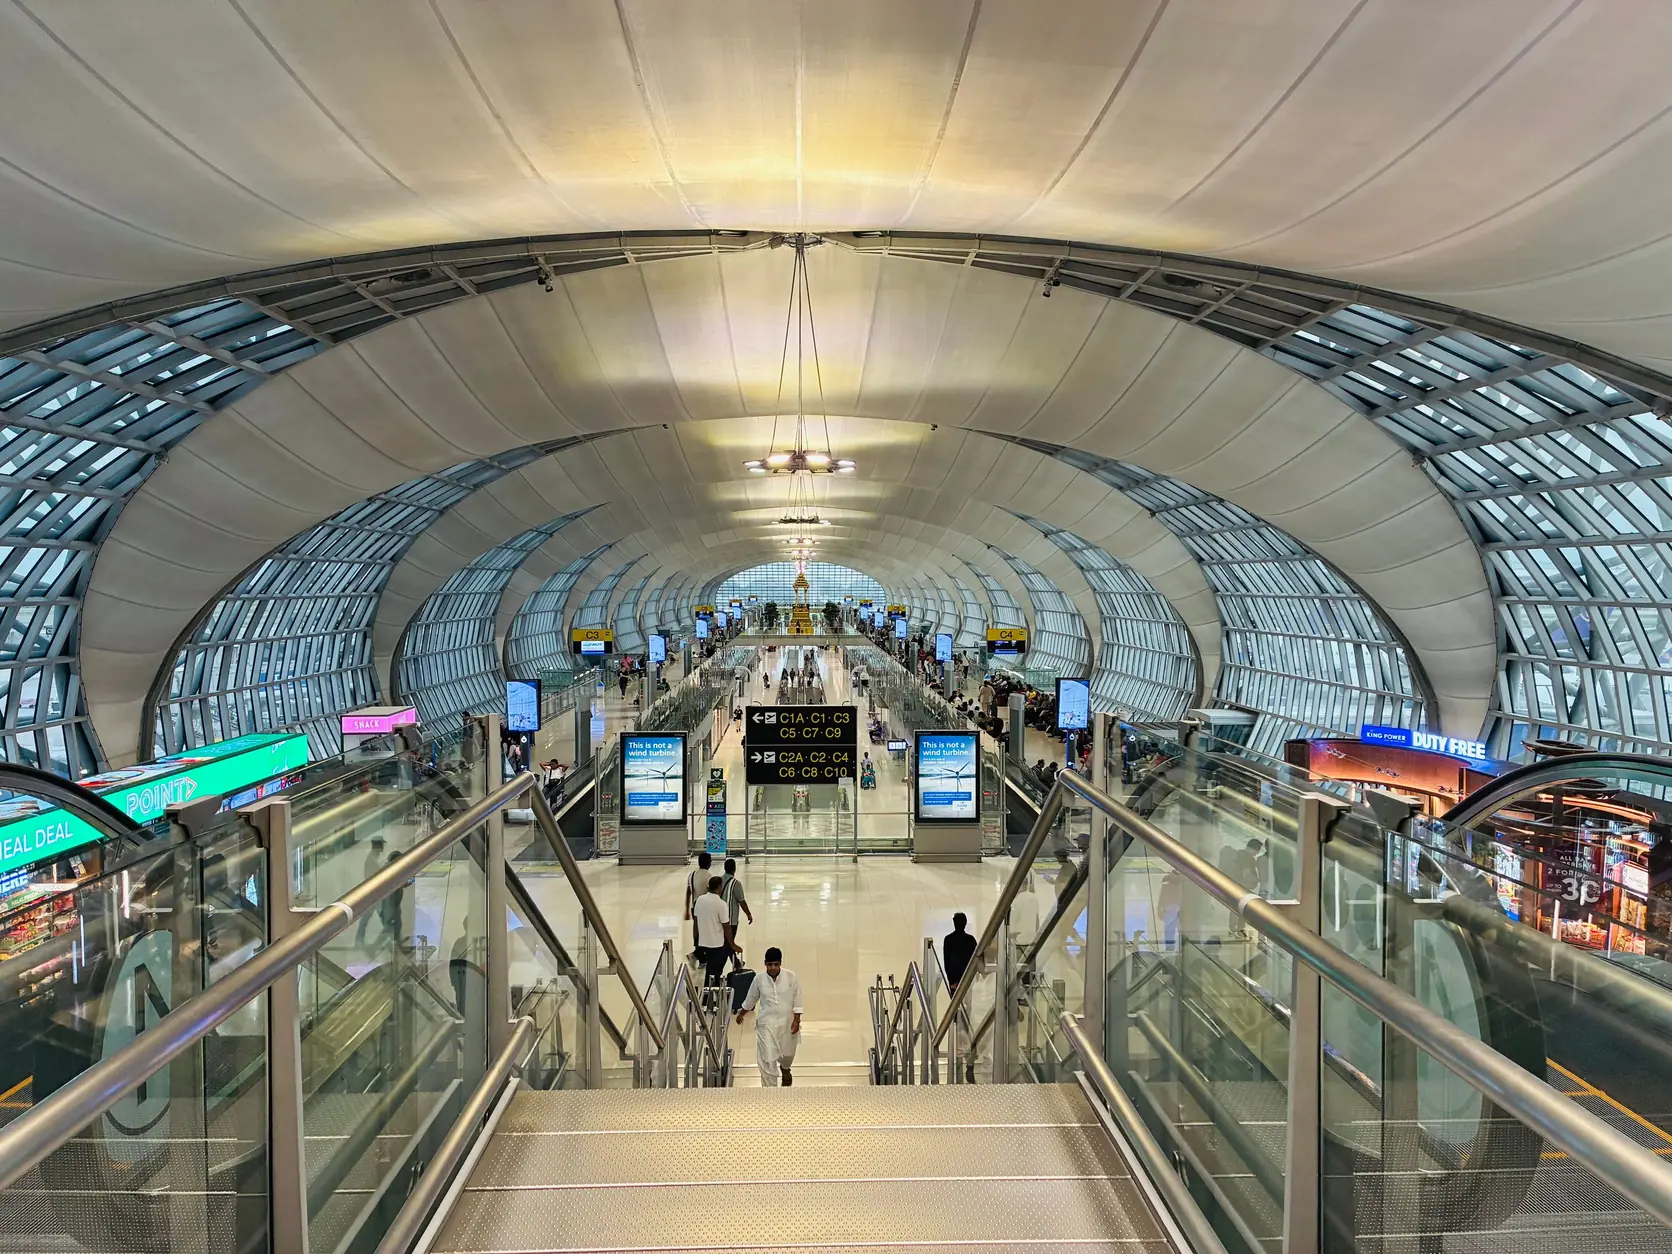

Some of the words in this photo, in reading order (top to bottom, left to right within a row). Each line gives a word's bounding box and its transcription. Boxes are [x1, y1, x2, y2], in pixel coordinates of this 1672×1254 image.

[585, 630, 600, 640] C3
[999, 630, 1013, 639] C4
[780, 712, 805, 724] C1A
[810, 712, 825, 724] C1
[833, 712, 850, 724] C3
[354, 719, 380, 729] SNACK
[780, 727, 796, 738] C5
[802, 727, 819, 738] C7
[825, 727, 841, 738] C9
[1366, 731, 1383, 739] KING
[1383, 733, 1407, 741] POWER
[1413, 731, 1448, 752] DUTY
[1449, 738, 1486, 760] FREE
[649, 749, 678, 757] turbine.
[779, 752, 804, 763] C2A
[810, 752, 826, 763] C2
[832, 752, 849, 763] C4
[779, 767, 796, 778] C6
[801, 767, 818, 778] C8
[824, 767, 848, 778] C10
[126, 776, 187, 818] POINT
[0, 833, 33, 860] EAL
[35, 820, 74, 849] DEAL
